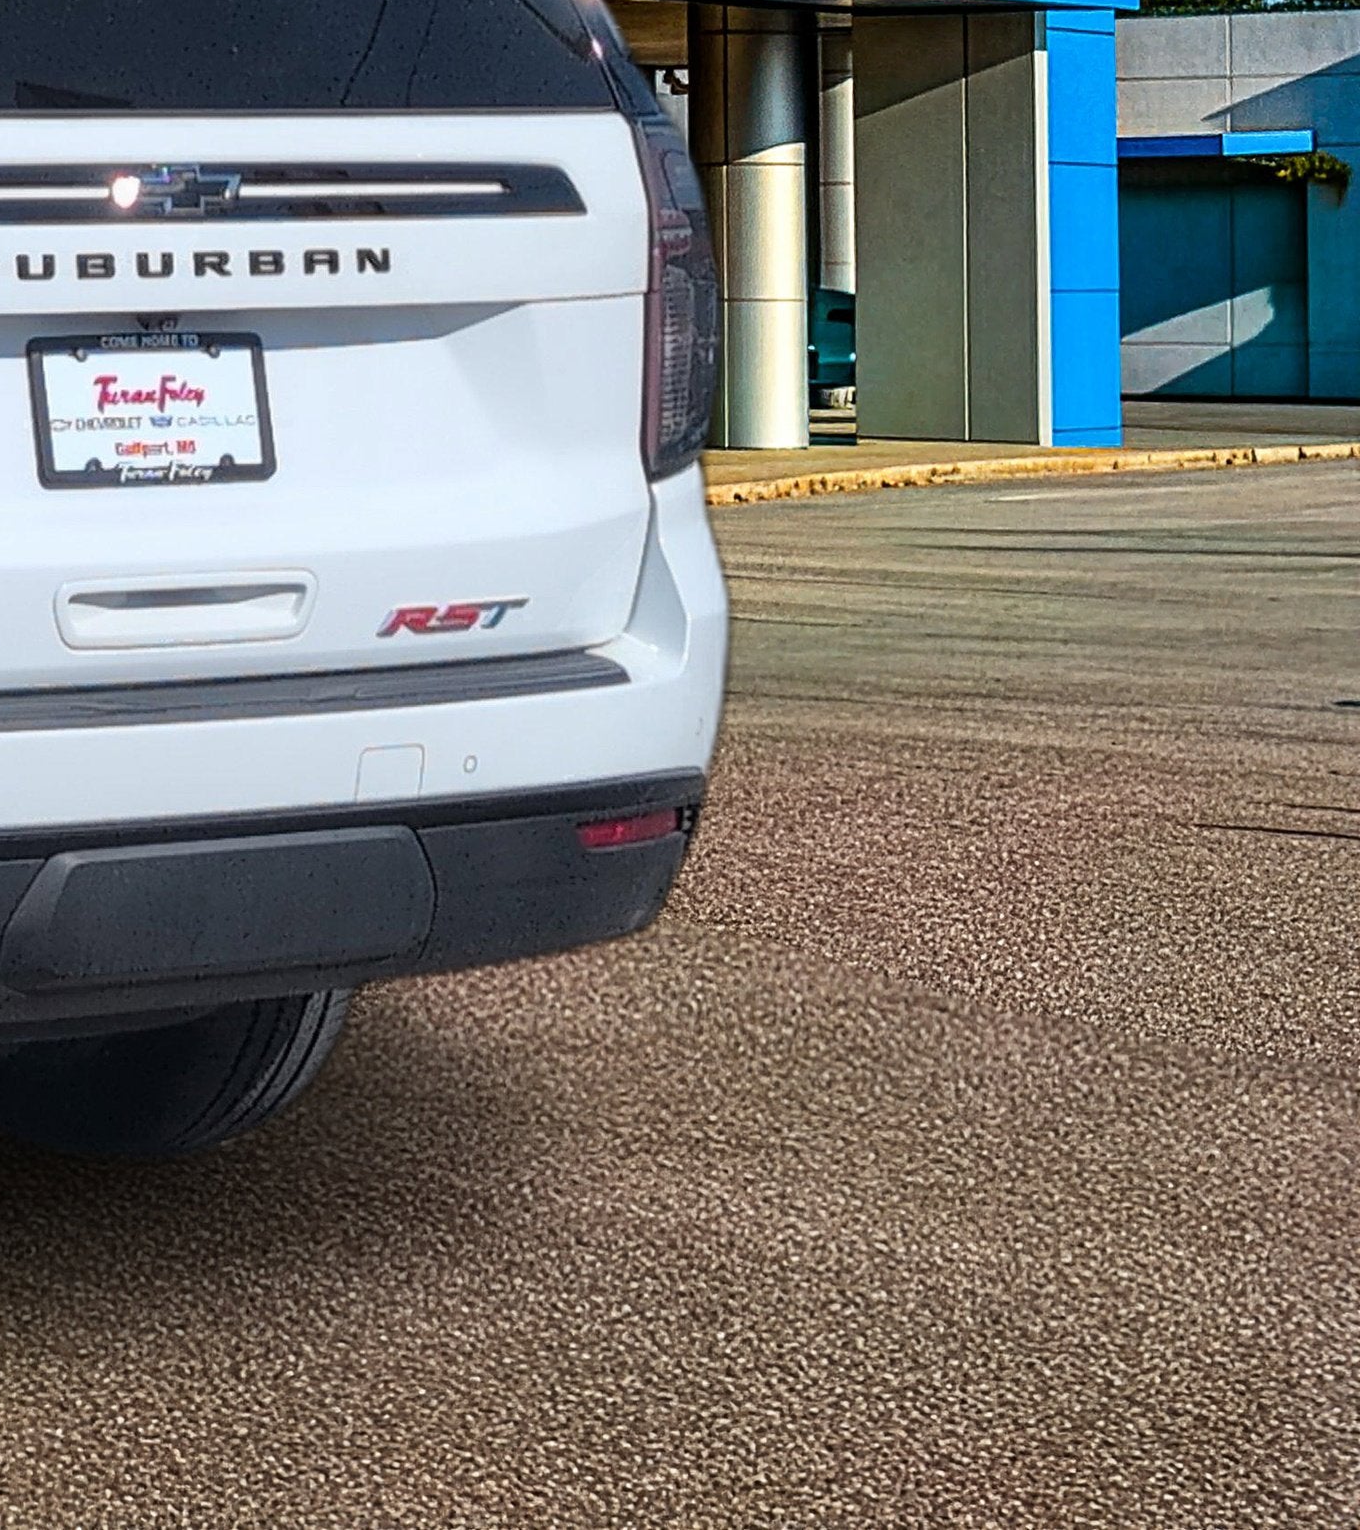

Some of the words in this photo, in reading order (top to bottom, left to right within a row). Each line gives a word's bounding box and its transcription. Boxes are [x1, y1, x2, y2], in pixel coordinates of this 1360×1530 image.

[76, 416, 143, 430] CHEVROLET
[177, 414, 256, 428] CADILLAC
[376, 597, 530, 638] RST
